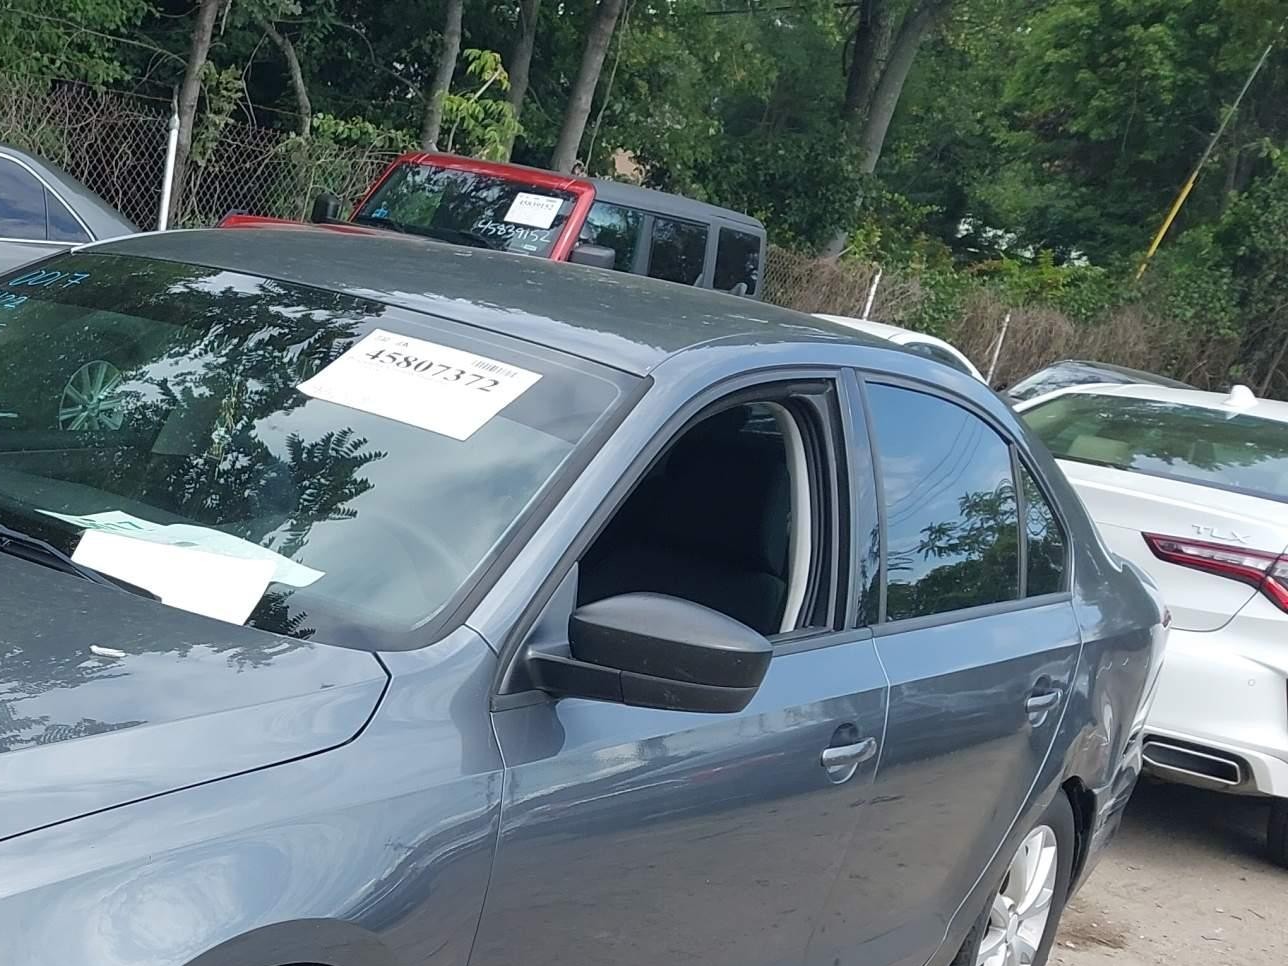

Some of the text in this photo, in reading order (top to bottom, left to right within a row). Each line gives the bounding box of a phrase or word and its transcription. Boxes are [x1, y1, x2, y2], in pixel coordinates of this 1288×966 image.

[478, 219, 551, 242] 45839152
[365, 349, 500, 392] 45807372
[1191, 524, 1252, 544] TLX
